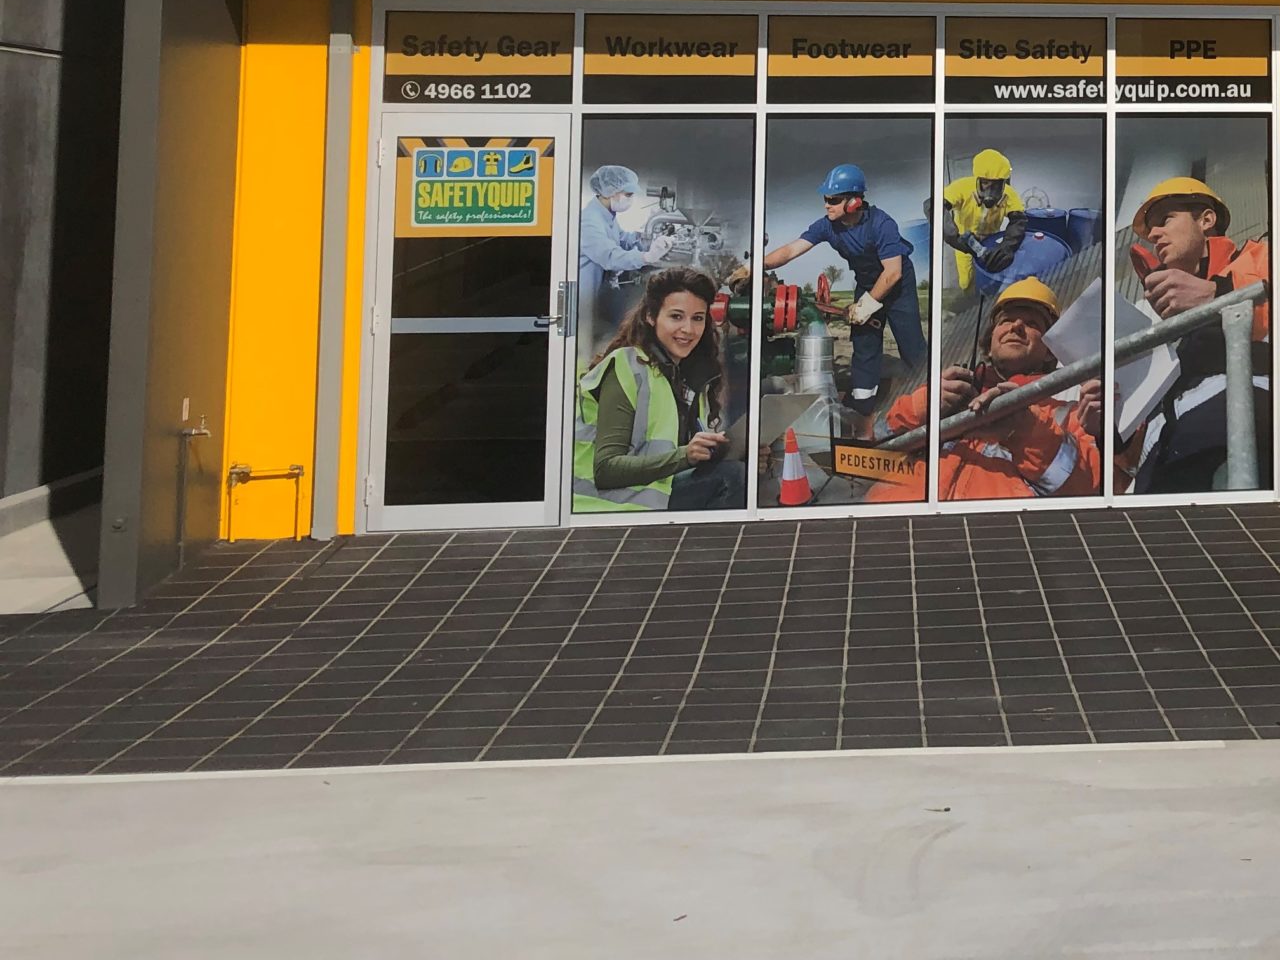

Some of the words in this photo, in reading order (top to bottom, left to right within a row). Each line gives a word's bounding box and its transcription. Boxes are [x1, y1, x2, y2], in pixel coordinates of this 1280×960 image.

[401, 36, 488, 61] Safety
[496, 36, 560, 57] Gear
[605, 37, 738, 58] Workwear
[792, 38, 912, 60] Footwear
[958, 39, 1008, 60] Site
[1014, 39, 1093, 64] Safety
[1170, 41, 1217, 60] PPE
[424, 83, 475, 99] 4966
[481, 83, 531, 99] 1102
[418, 182, 532, 210] SAFETYQUIP
[418, 211, 432, 220] The
[436, 212, 463, 222] safety
[466, 210, 531, 222] professionals!
[840, 453, 914, 476] PEDESTRIAN
